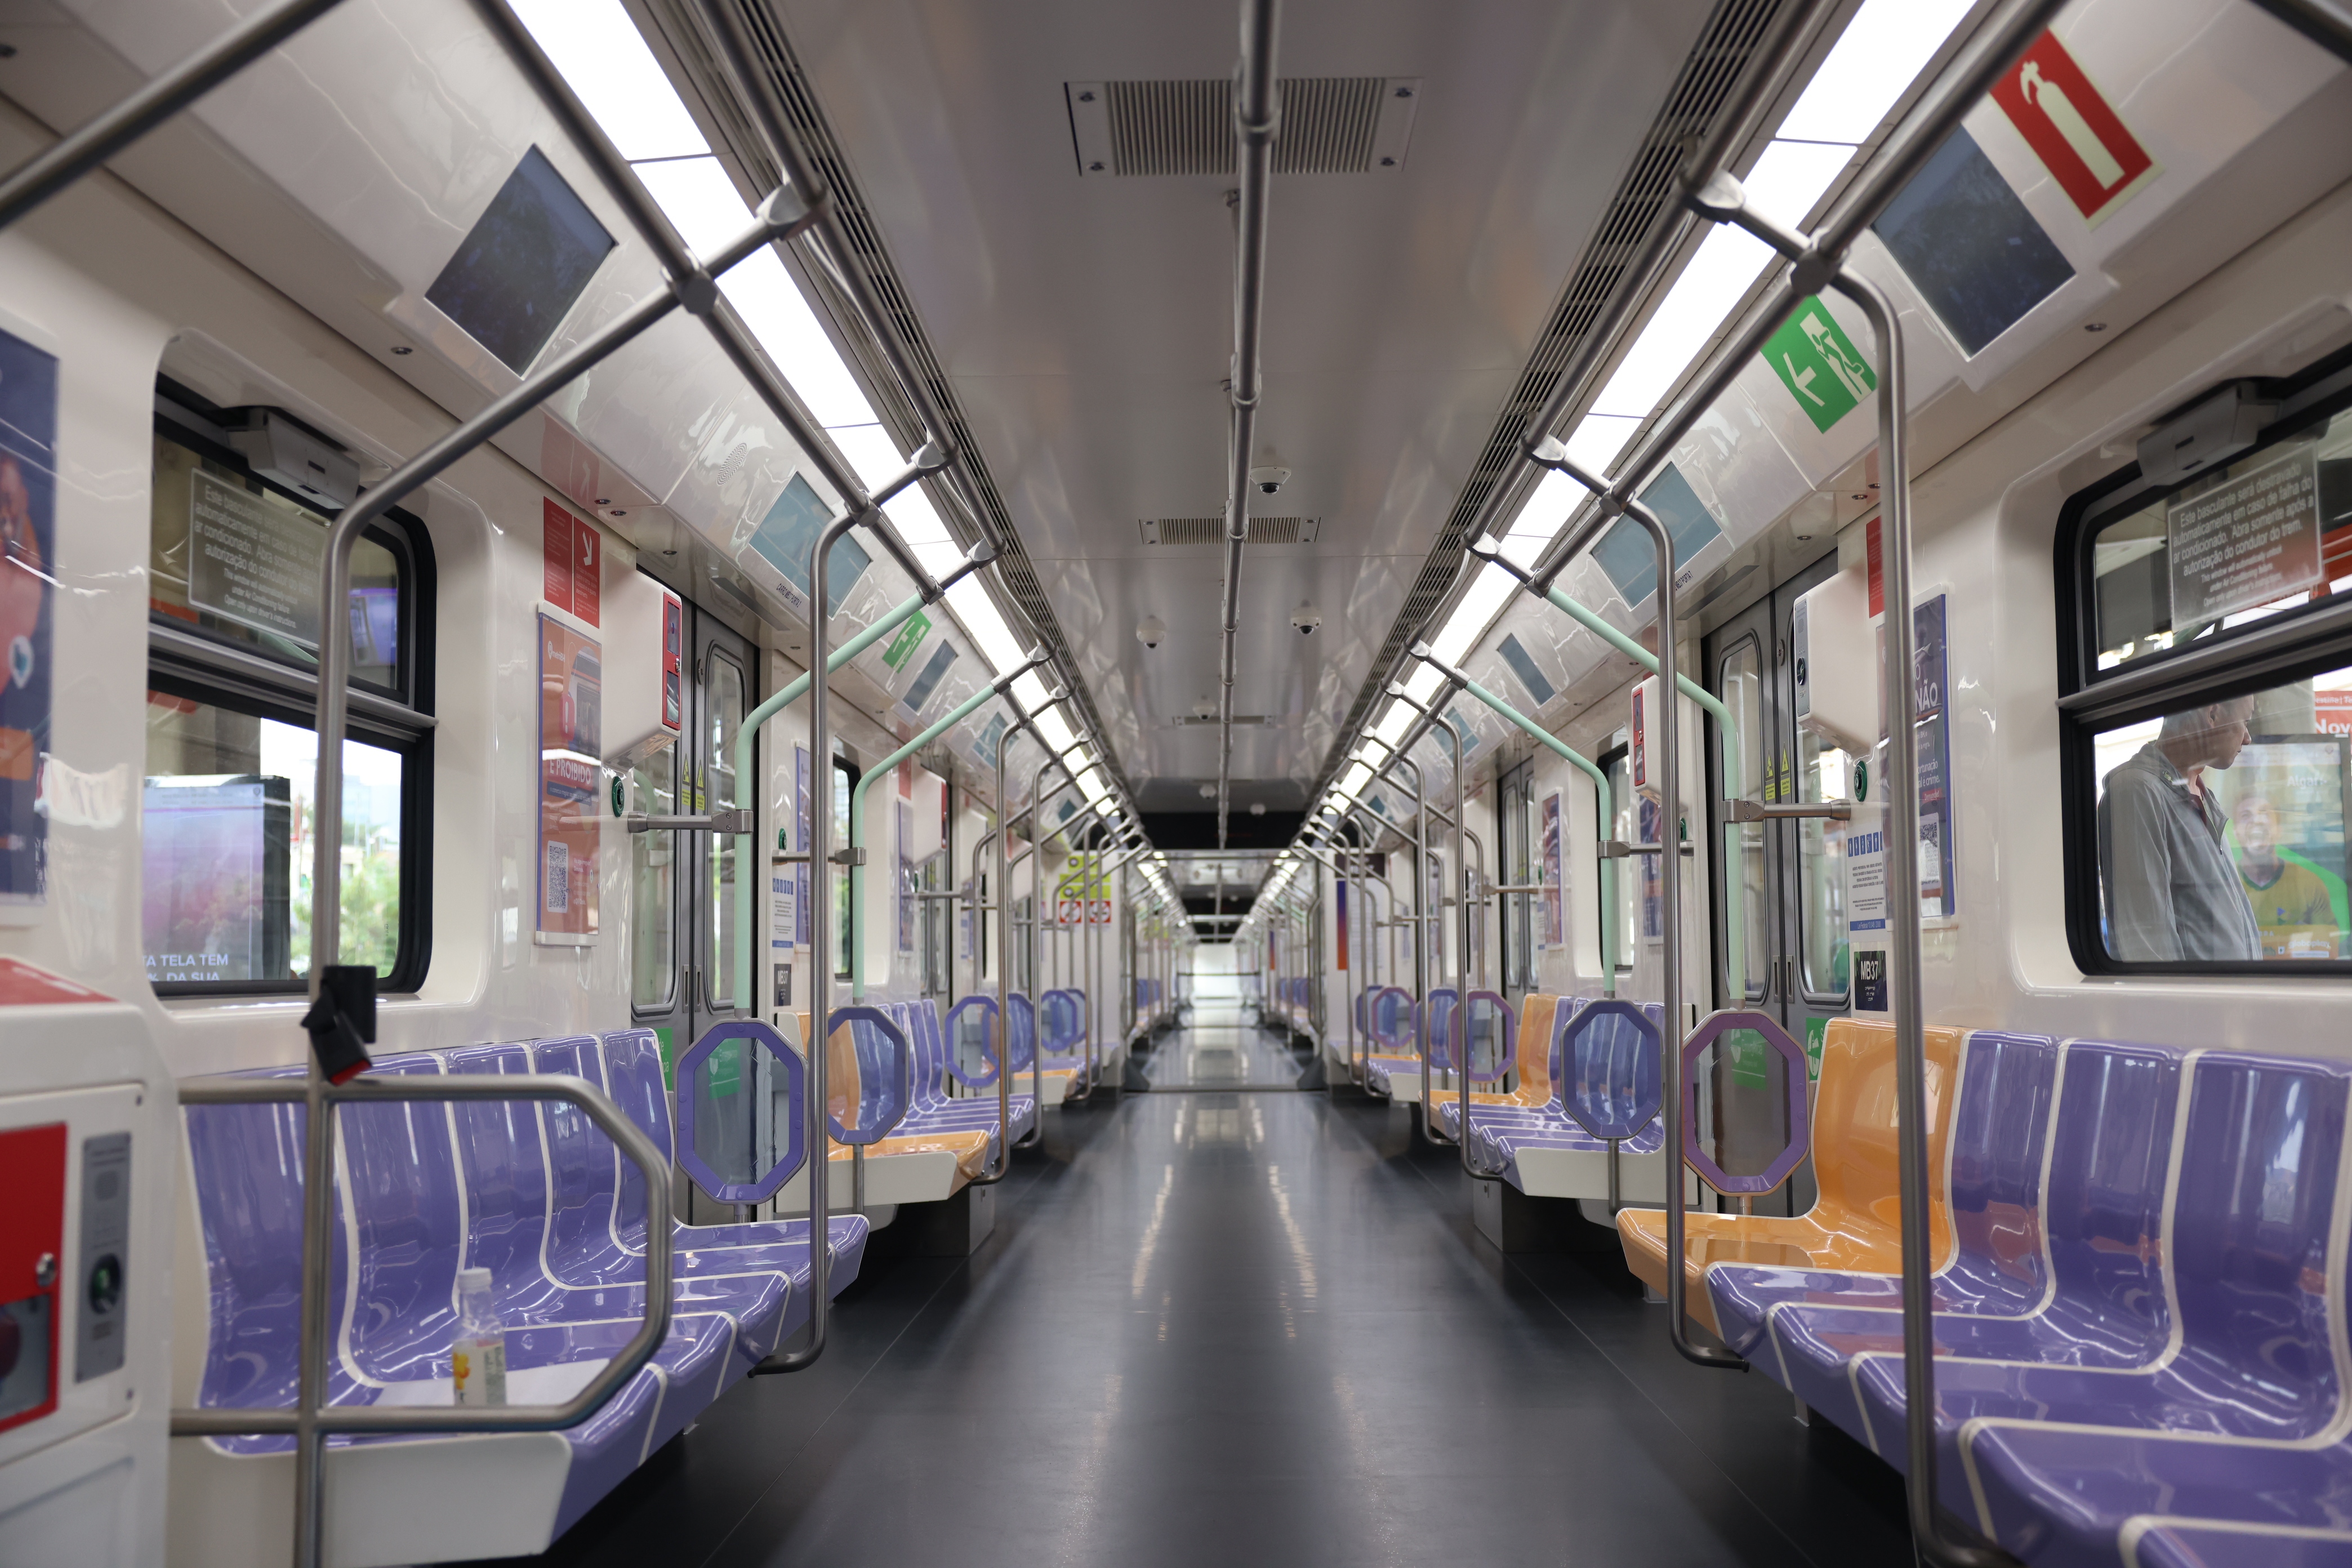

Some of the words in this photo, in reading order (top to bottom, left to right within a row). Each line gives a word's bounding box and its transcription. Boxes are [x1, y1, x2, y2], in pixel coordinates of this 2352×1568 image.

[205, 485, 223, 506] Este
[2180, 511, 2196, 528] Este
[2197, 492, 2236, 520] basculante
[2238, 483, 2254, 501] será
[194, 520, 202, 533] ar
[195, 502, 257, 540] automaticamente
[2173, 513, 2231, 547] automaticamente
[2233, 506, 2246, 520] em
[2247, 498, 2266, 515] caso
[2267, 491, 2278, 506] de
[2173, 552, 2181, 564] ar
[2182, 532, 2229, 560] condicionado.
[2231, 522, 2249, 538] Abra
[2251, 507, 2284, 531] somente
[205, 543, 247, 571] autorização
[2184, 551, 2223, 577] autorização
[2225, 545, 2234, 559] do
[2235, 531, 2269, 555] condutor
[2270, 525, 2280, 541] do
[776, 583, 787, 595] CARRO
[1915, 678, 1938, 713] NÃO
[556, 758, 591, 785] PROIBIDO
[1926, 773, 1940, 786] crime.
[160, 954, 196, 966] TELA
[199, 953, 229, 966] TEM
[1860, 961, 1879, 980] MB37
[166, 972, 187, 982] DA
[191, 972, 220, 981] SUA
[777, 970, 789, 985] MB37
